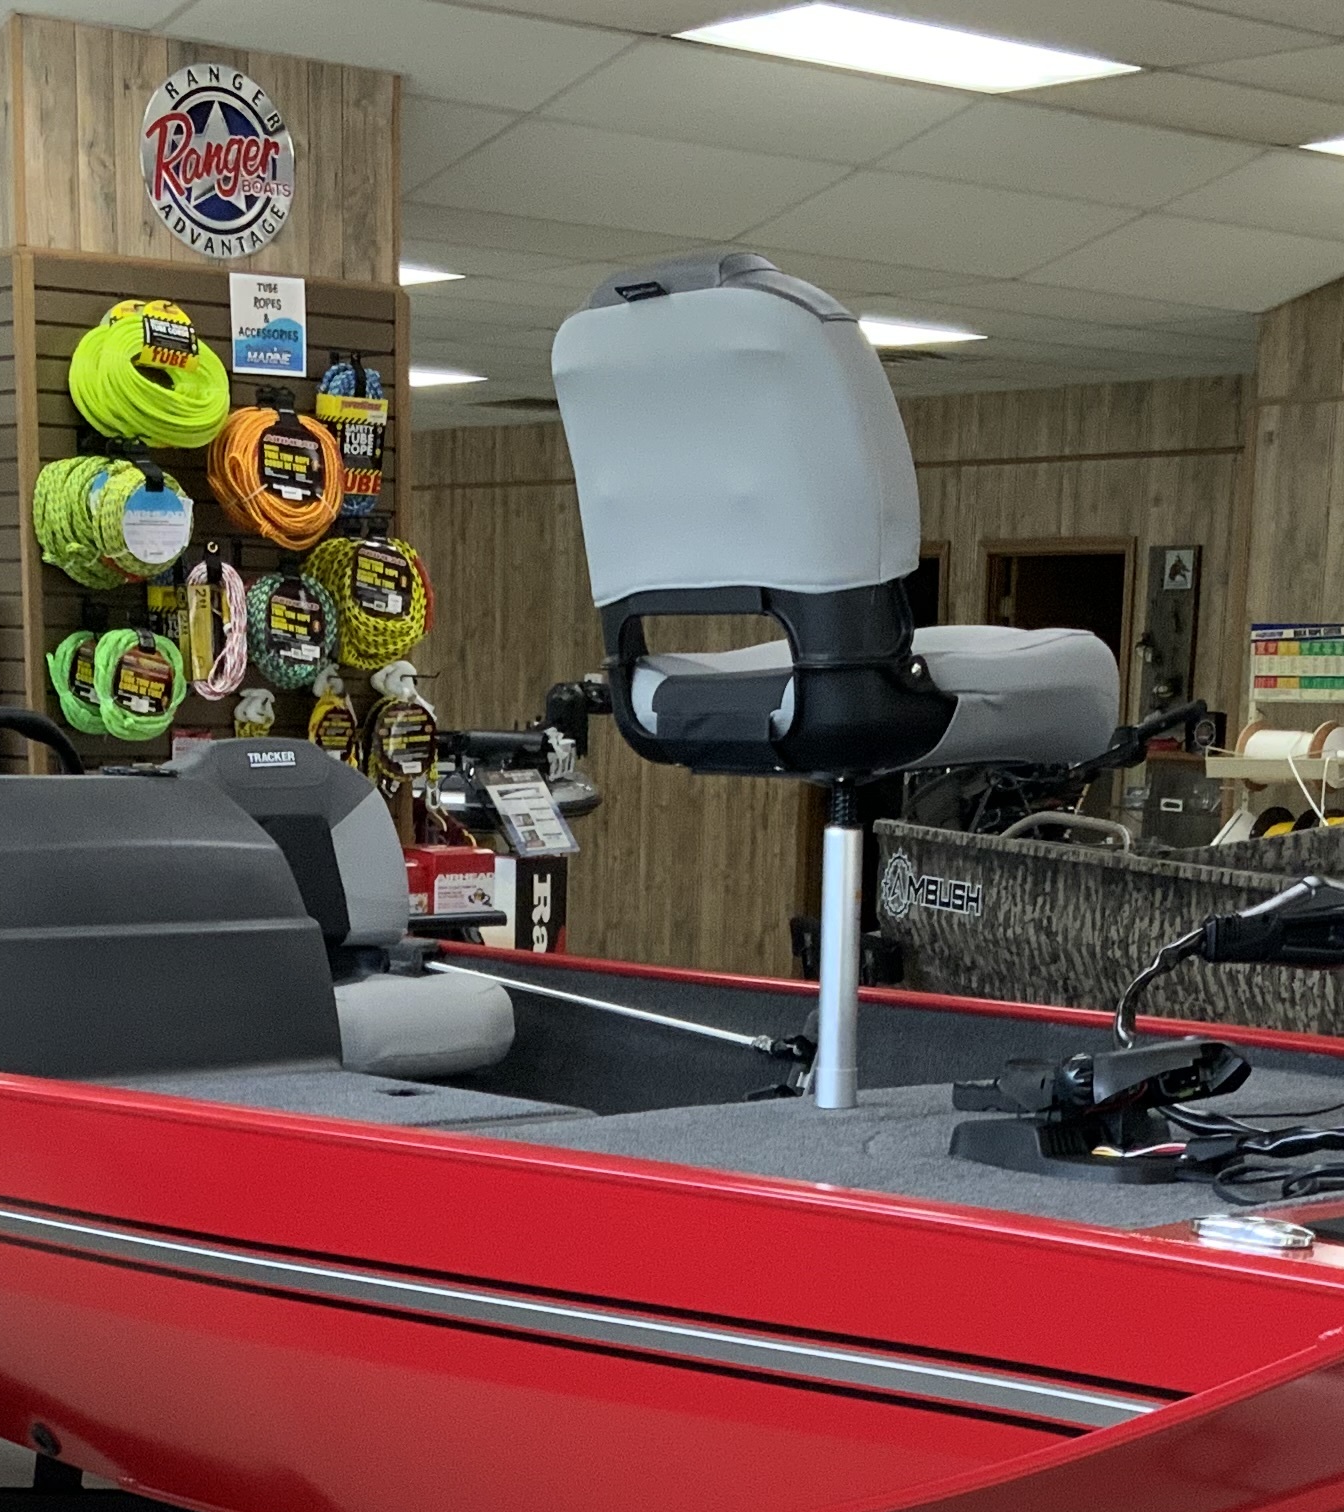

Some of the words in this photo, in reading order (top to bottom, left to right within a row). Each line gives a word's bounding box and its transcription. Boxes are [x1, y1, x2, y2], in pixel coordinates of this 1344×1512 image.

[165, 66, 284, 131] RANGER
[146, 112, 279, 200] Ranger
[241, 179, 291, 197] BOATS
[159, 204, 286, 256] ADVANTAGE
[257, 283, 278, 293] TUBE
[254, 297, 281, 310] ROPES
[263, 314, 270, 323] &
[239, 327, 299, 342] ACCESSORIES
[151, 347, 189, 368] TUBE
[247, 351, 292, 365] MARINE
[345, 424, 374, 433] SAFETY
[345, 433, 375, 445] TUBE
[344, 443, 374, 456] ROPE
[248, 752, 296, 763] TRACKER
[436, 873, 495, 881] AIRHEAD
[887, 867, 982, 916] AMBUSH
